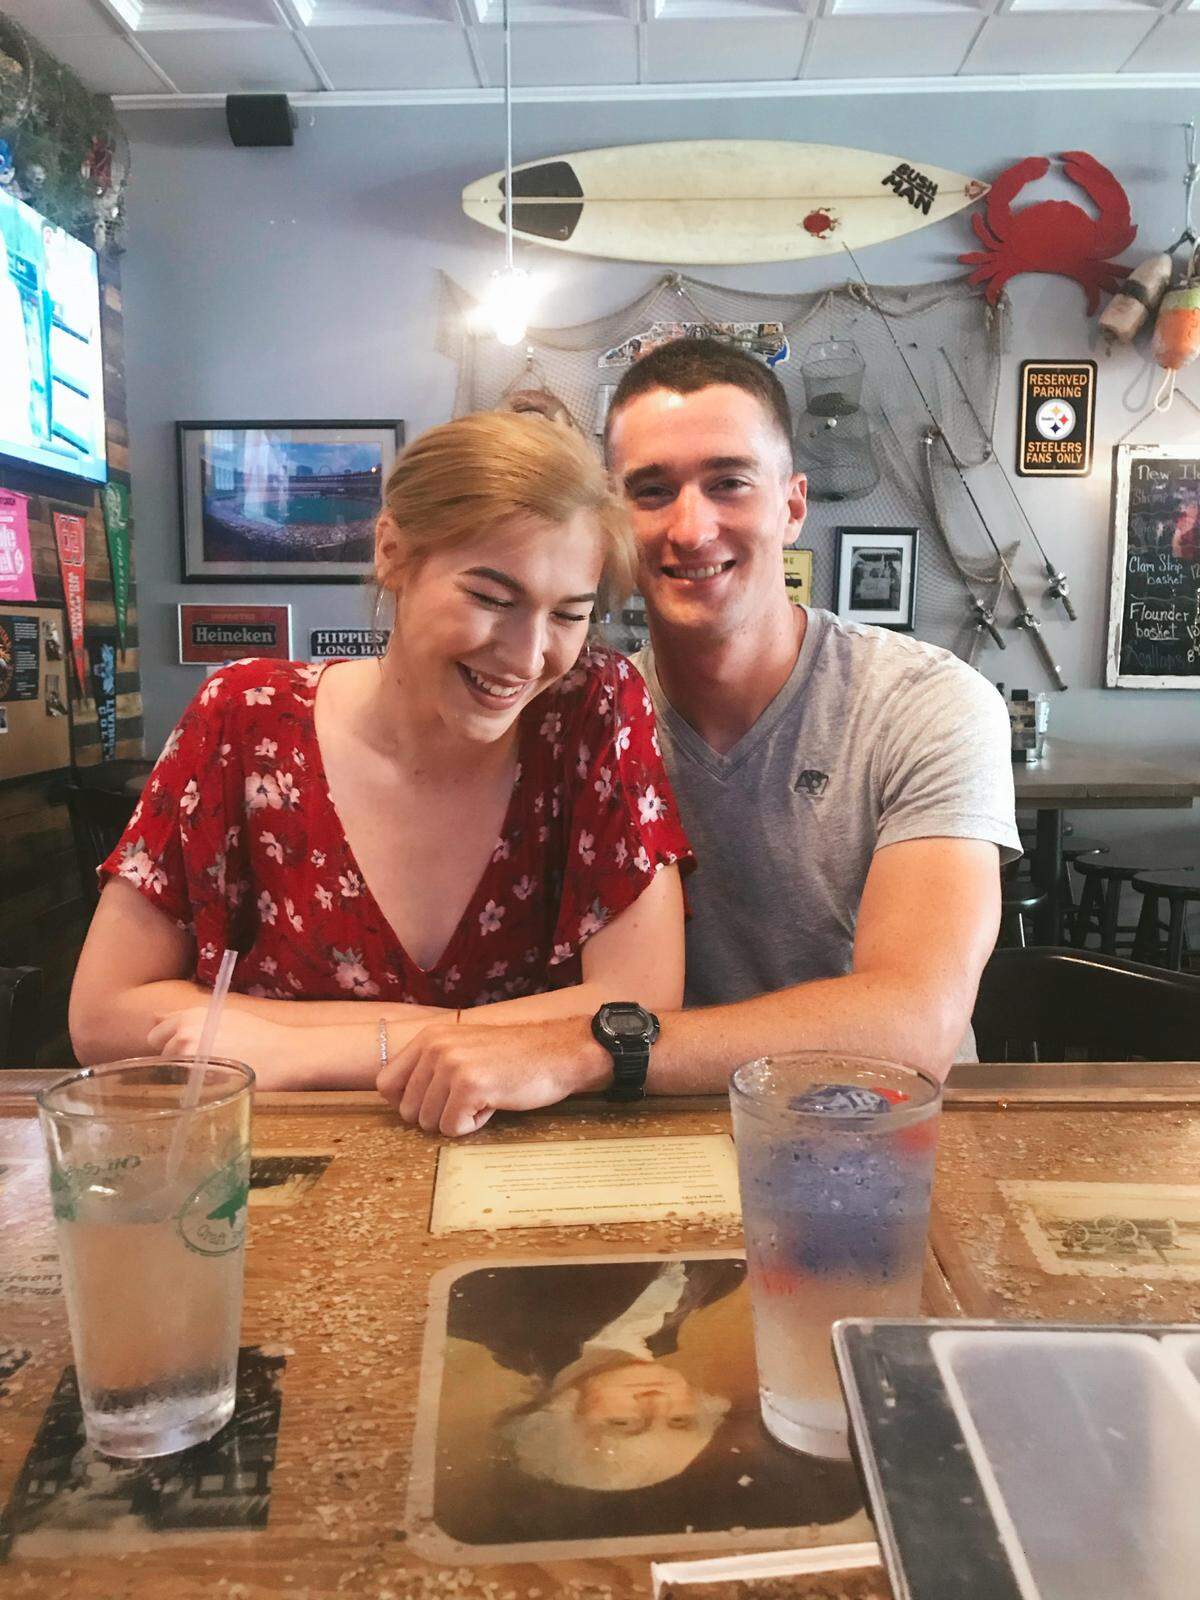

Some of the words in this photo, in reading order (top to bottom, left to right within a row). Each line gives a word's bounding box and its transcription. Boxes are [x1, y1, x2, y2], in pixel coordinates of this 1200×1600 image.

[881, 174, 933, 216] MAN
[1029, 374, 1088, 386] RESERVED
[1033, 386, 1082, 398] PARKING
[1027, 441, 1082, 453] STEELERS
[1026, 453, 1052, 464] FANS
[1056, 453, 1083, 464] ONLY
[1129, 555, 1155, 573] Clam
[1147, 573, 1187, 585] basket
[1129, 602, 1189, 621] Flounder
[196, 627, 273, 643] Heineken
[1135, 621, 1178, 638] basket
[316, 632, 384, 644] HIPPIES
[316, 645, 357, 655] LONG
[361, 645, 388, 655] HAI
